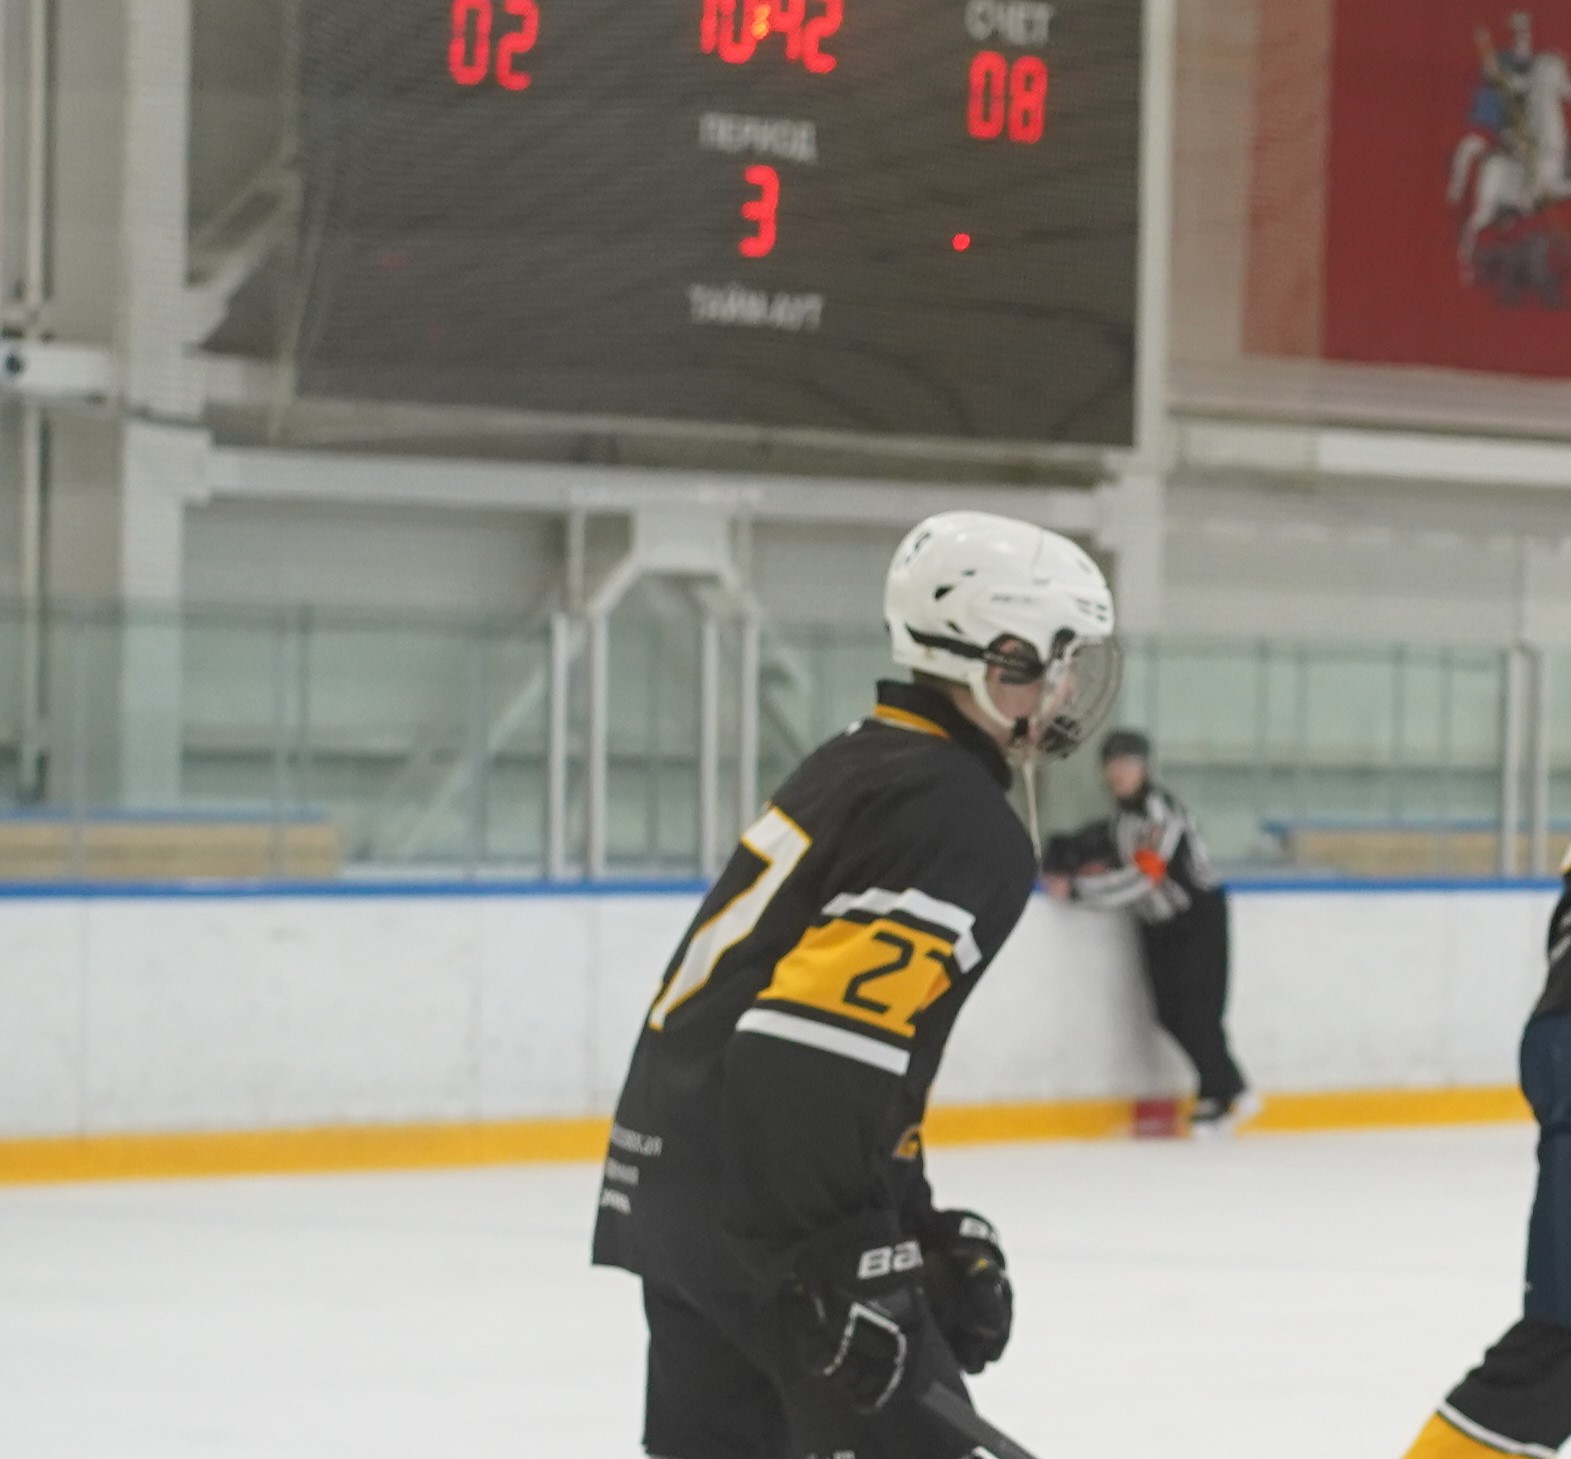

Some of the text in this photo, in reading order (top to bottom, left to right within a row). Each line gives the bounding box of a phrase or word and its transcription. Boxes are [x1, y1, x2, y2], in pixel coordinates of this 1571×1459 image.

[448, 0, 540, 90] 02
[967, 49, 1048, 144] 08
[738, 165, 780, 258] 3
